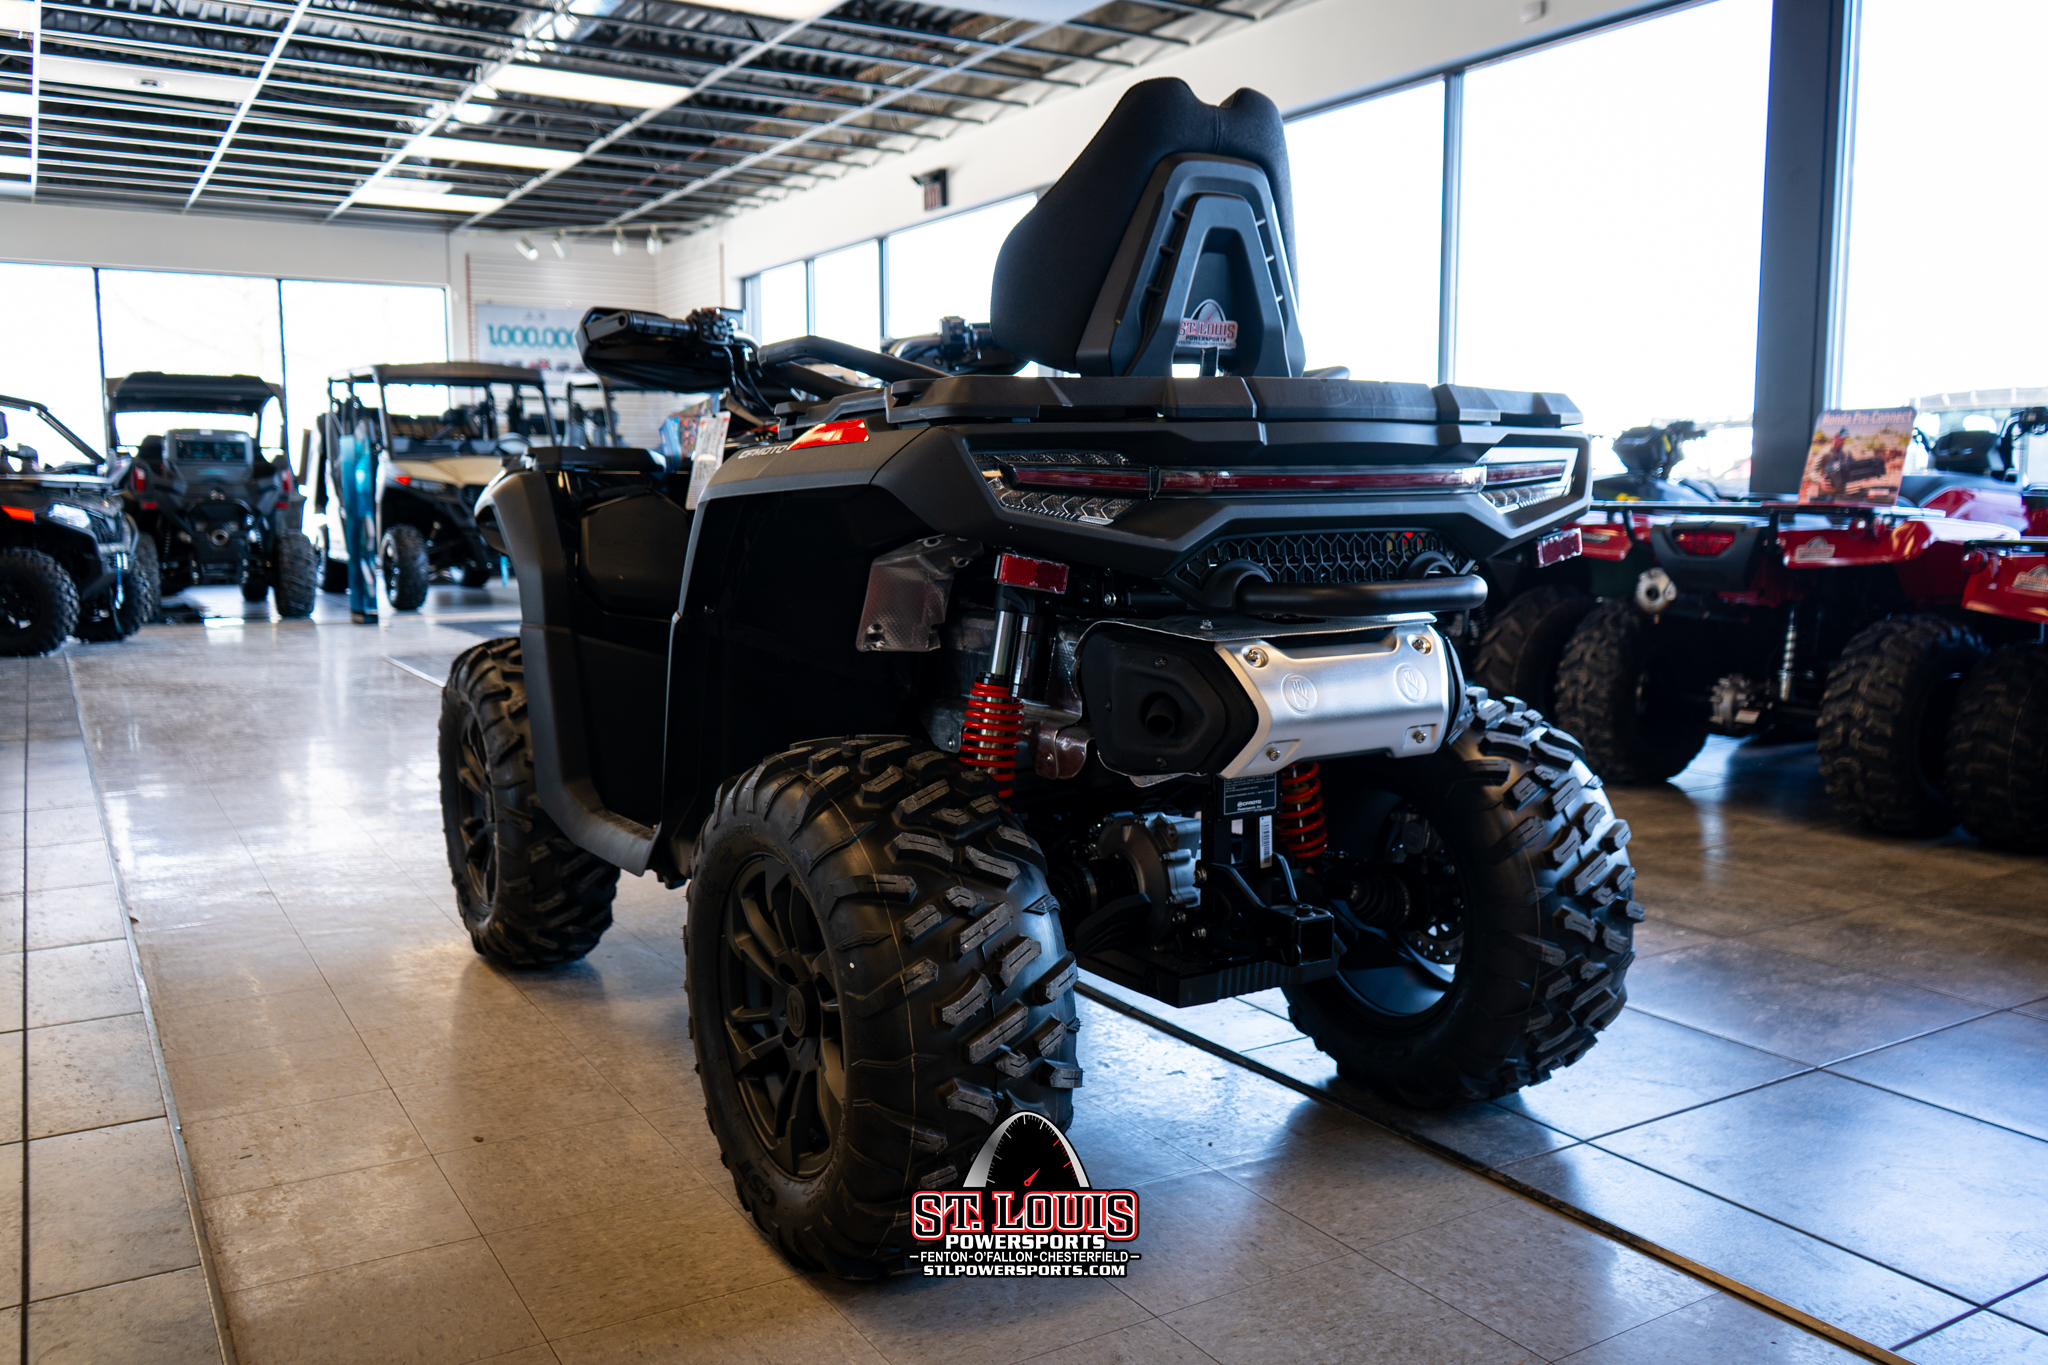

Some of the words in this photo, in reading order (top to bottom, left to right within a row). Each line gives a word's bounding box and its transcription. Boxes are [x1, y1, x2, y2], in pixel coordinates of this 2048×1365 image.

[1199, 321, 1237, 339] LOUIS
[1185, 335, 1227, 343] POWERSPORTS
[1822, 411, 1852, 426] Honda
[1852, 410, 1914, 426] Pro-Connect
[738, 444, 788, 459] CFMOTO
